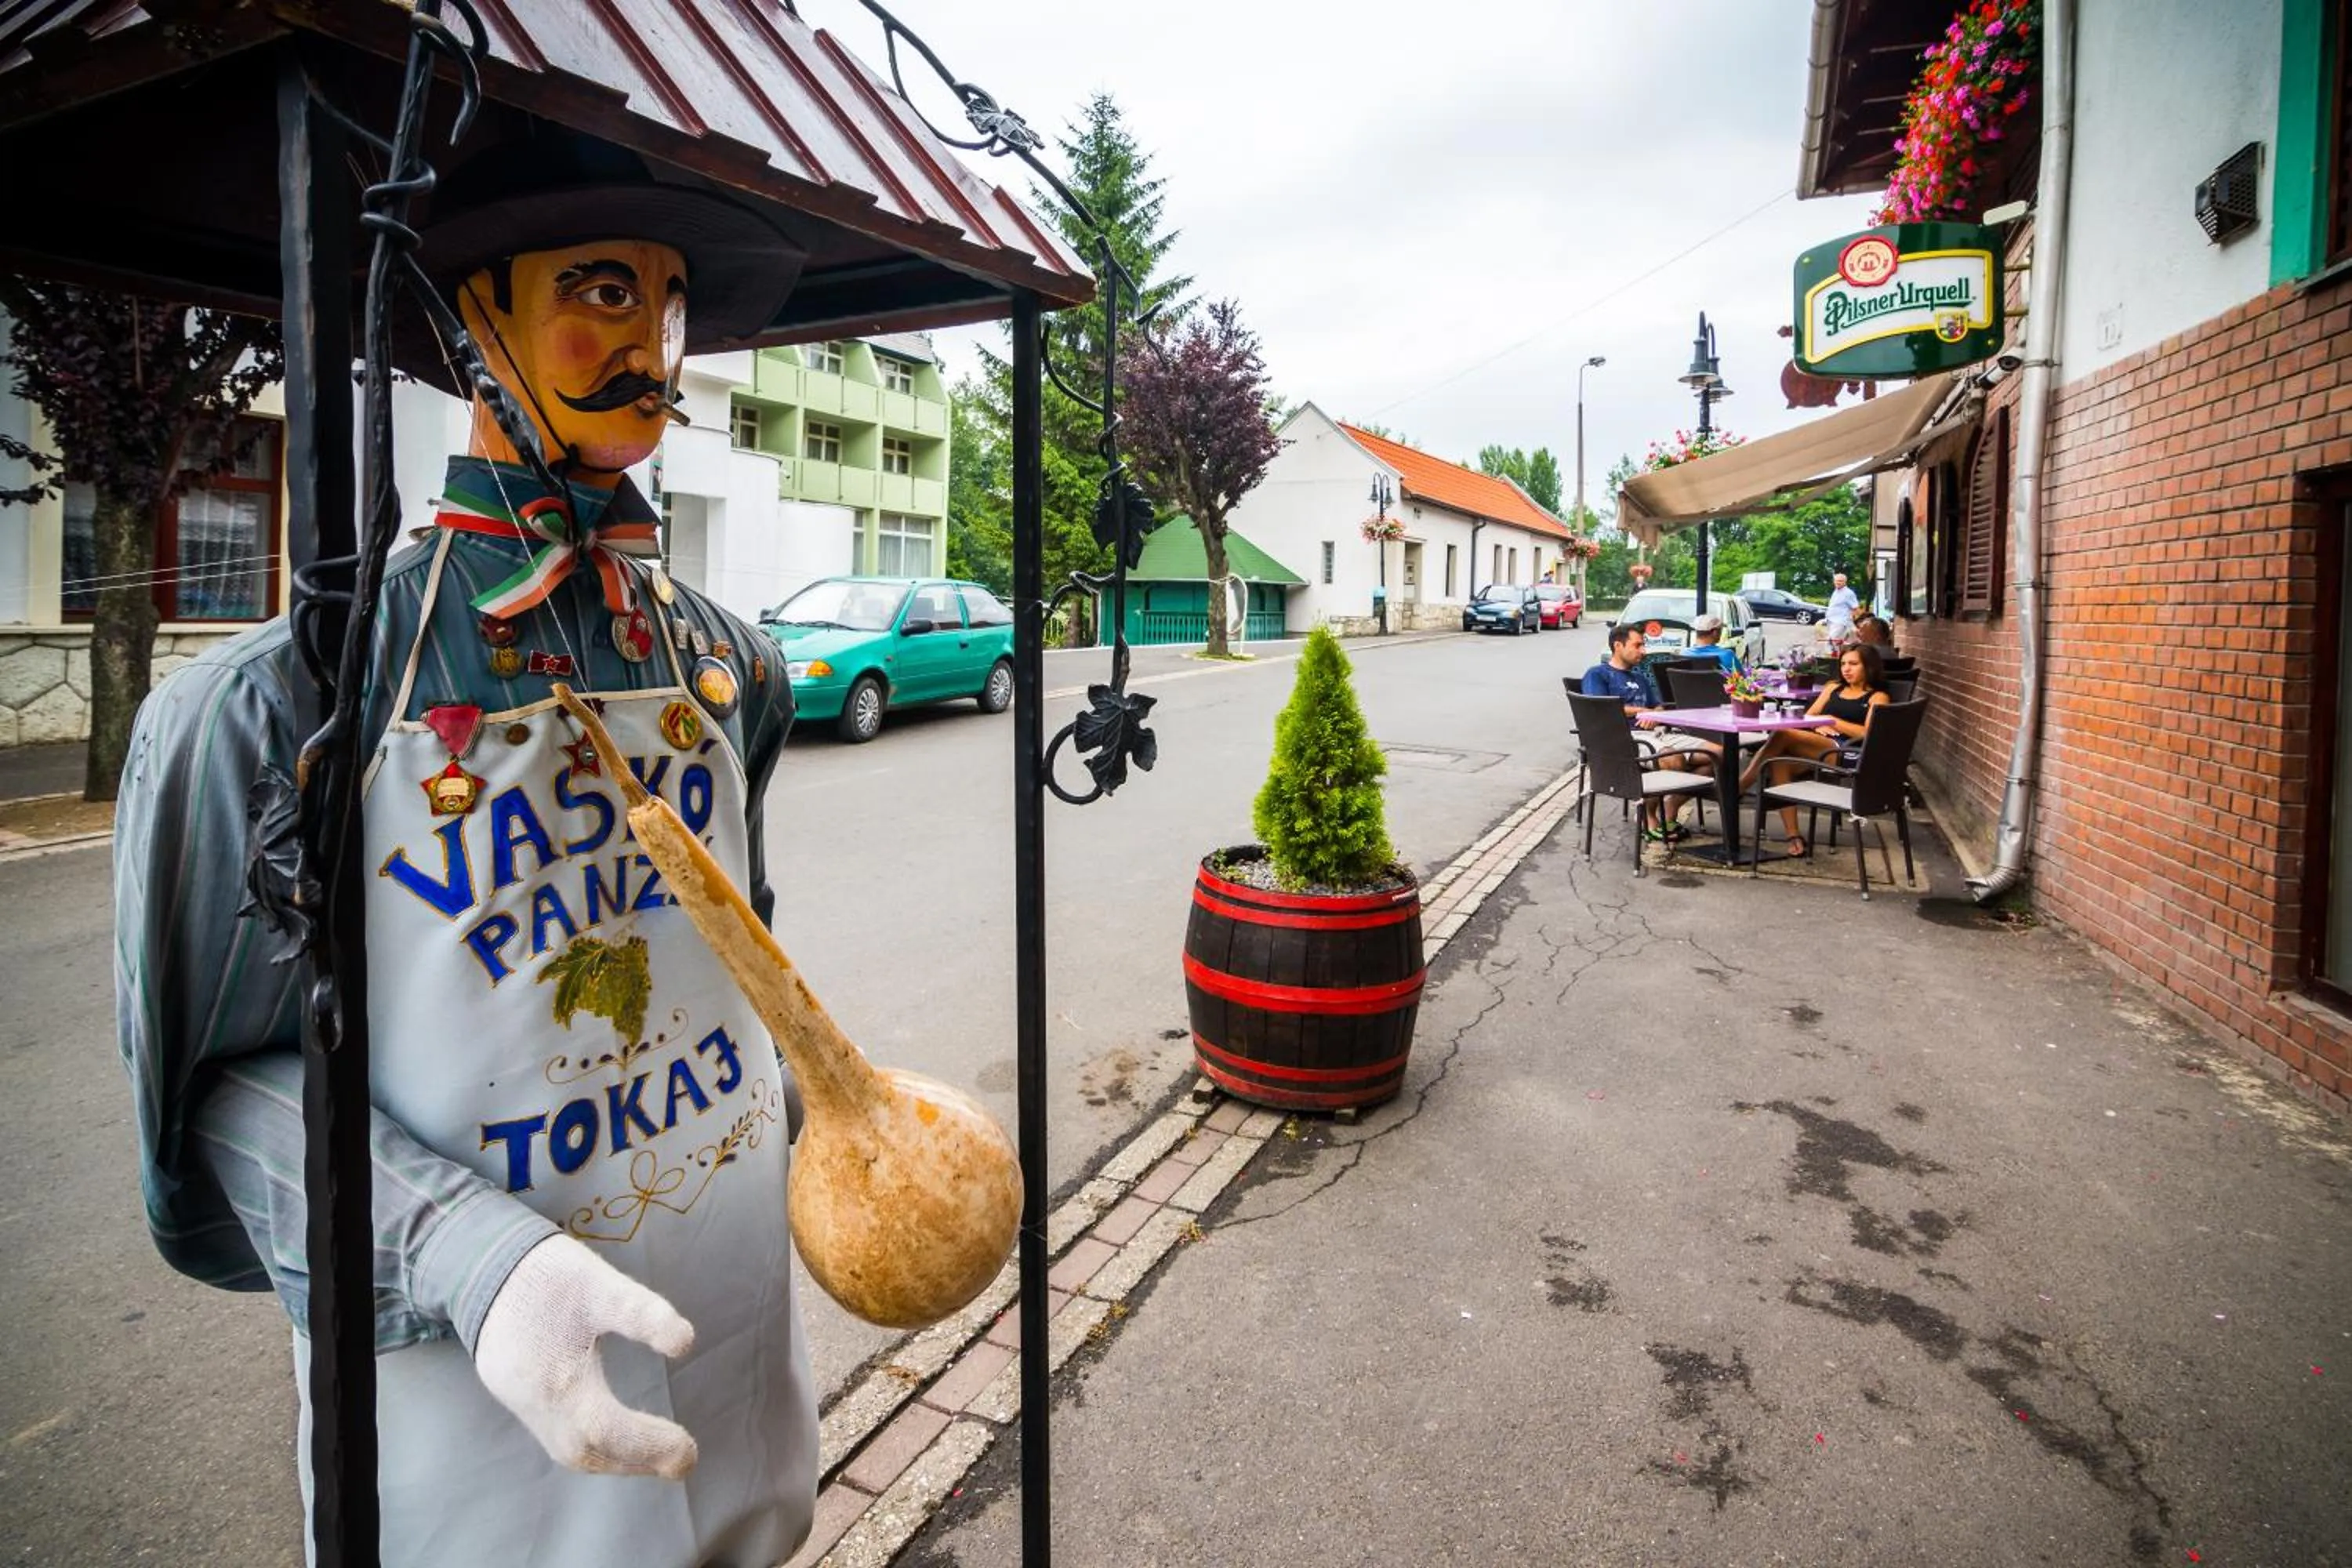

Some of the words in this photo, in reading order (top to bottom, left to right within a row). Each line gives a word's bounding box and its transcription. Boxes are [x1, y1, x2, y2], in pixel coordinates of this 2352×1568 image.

[1824, 292, 1897, 336] Pilsner
[1896, 277, 1970, 312] Urquell
[460, 835, 715, 988] PANZ
[480, 1022, 742, 1194] TOKAJ
